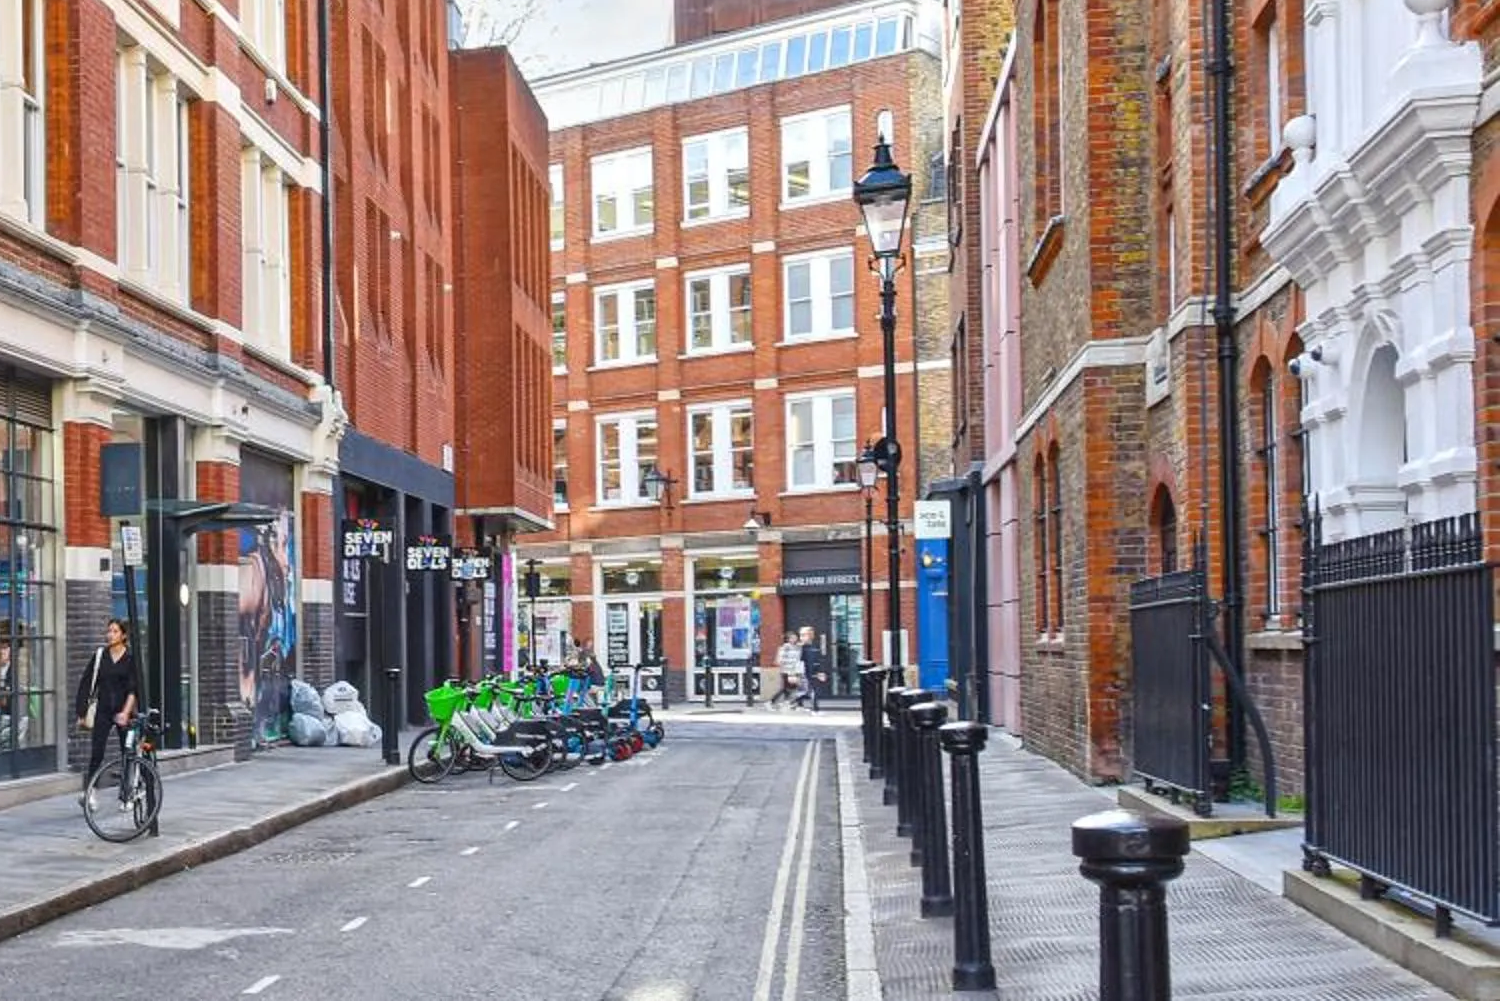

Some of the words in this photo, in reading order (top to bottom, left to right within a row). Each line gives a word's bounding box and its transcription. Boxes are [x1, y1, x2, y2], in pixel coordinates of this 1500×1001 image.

[344, 530, 393, 544] SEVEN
[344, 543, 381, 557] DIAL
[406, 546, 450, 558] SEVEN
[406, 557, 447, 570] DIALS
[451, 568, 488, 579] DLS
